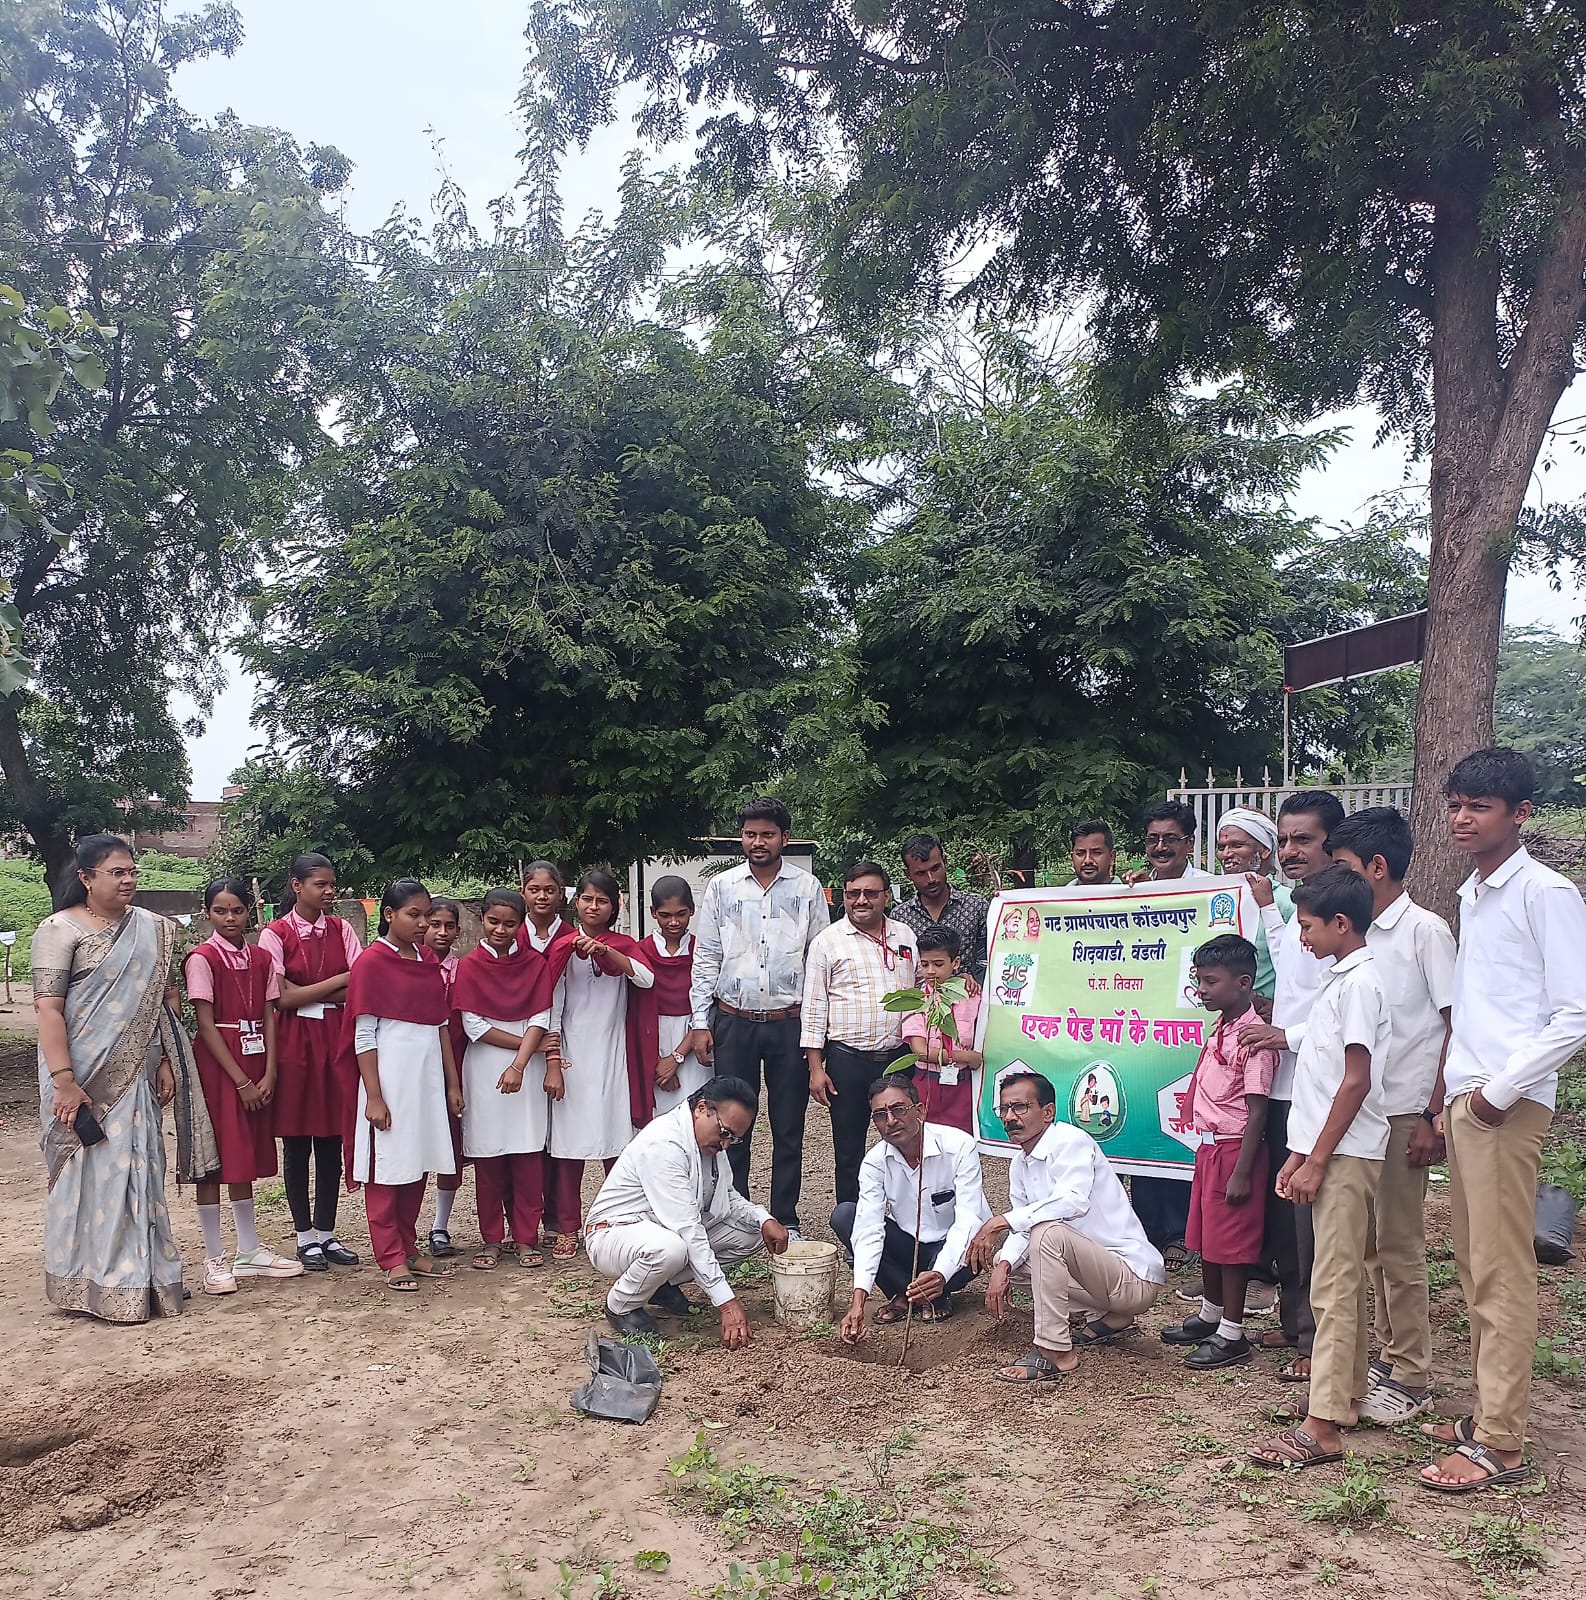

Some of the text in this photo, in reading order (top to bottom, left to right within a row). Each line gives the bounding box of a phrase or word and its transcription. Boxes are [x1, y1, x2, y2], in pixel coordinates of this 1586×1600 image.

[1044, 916, 1061, 932] गट
[1064, 909, 1129, 933] ग्रामपंचायत
[1131, 938, 1167, 961] वंडली
[1114, 973, 1144, 990] तिवसा
[1021, 1014, 1062, 1041] एक
[1067, 1008, 1095, 1042] पेड
[1128, 1009, 1149, 1045] के
[1153, 1020, 1204, 1047] नाम
